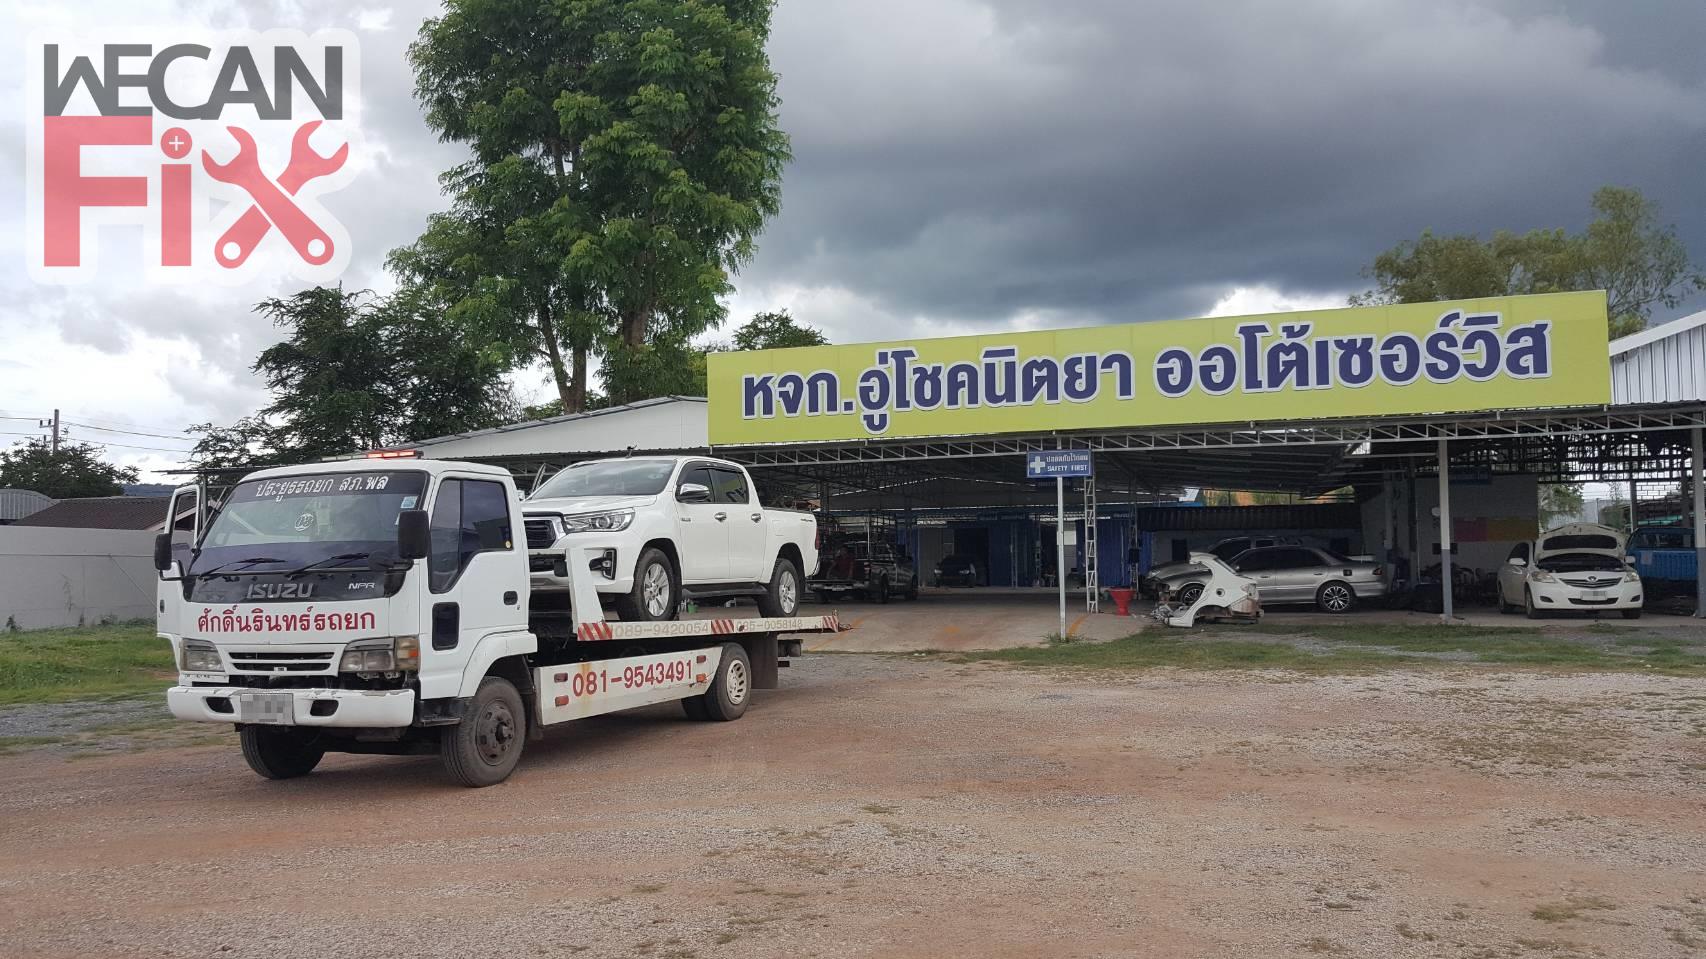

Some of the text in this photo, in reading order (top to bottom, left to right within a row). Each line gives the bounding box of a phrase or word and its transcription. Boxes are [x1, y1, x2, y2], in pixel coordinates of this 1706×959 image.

[743, 310, 1551, 434] หจก.อู่โชคนิตยา ออโต้เซอร์วิส
[246, 582, 376, 599] ISUZU NPR
[198, 605, 376, 633] ศักดิ์นรินทร์รถยก
[615, 623, 709, 637] 089-9420054
[572, 659, 693, 697] 081-9543491
